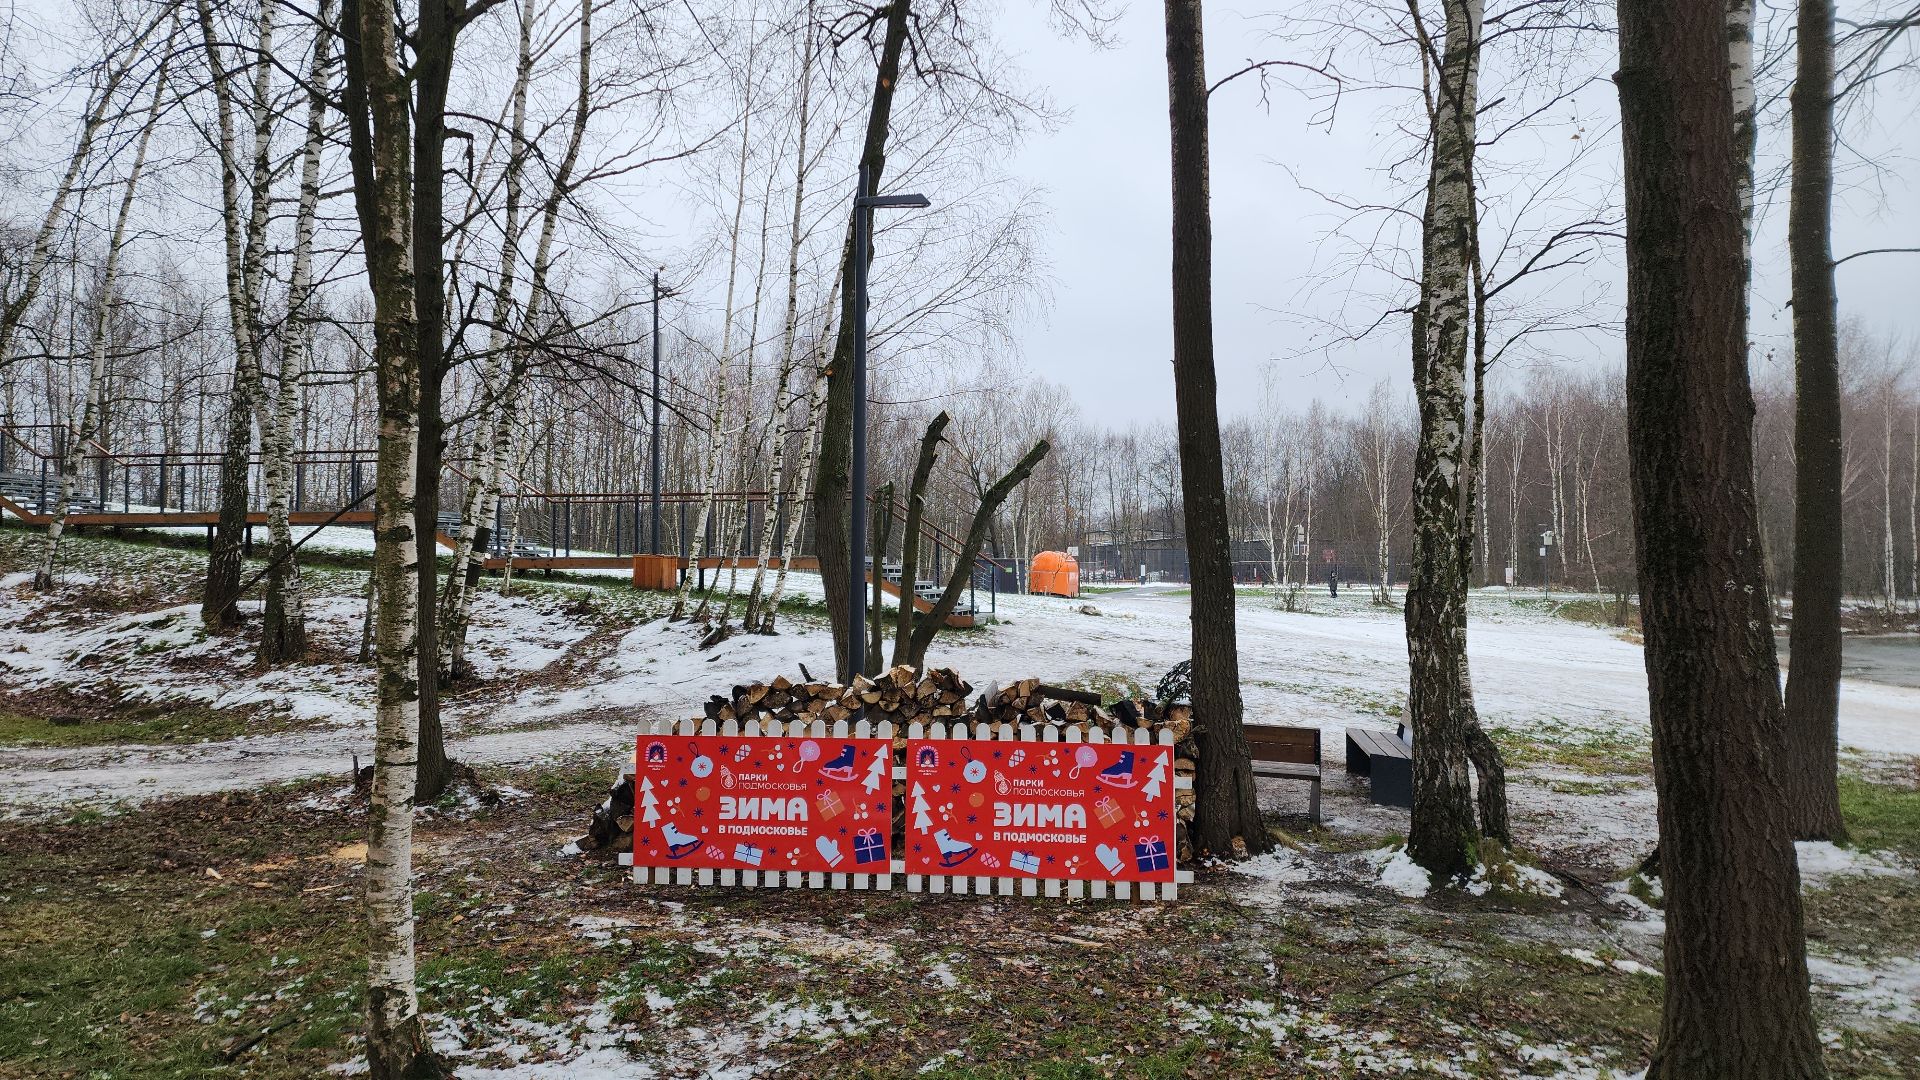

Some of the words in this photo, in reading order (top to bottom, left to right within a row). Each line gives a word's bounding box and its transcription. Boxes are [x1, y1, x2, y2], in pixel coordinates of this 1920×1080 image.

[739, 773, 768, 781] ПАРКИ
[738, 782, 807, 791] ПОДМОСКОВЬЯ
[1013, 779, 1044, 787] ПАРКИ
[1013, 788, 1085, 797] ПОДМОСКОВЬЯ
[719, 796, 808, 821] ЗИМА
[993, 802, 1087, 828] ЗИМА
[718, 825, 726, 834] В
[727, 825, 808, 836] ПОДМОСКОВЬЕ
[993, 832, 1001, 841] В
[1003, 832, 1087, 844] ПОДМОСКОВЬЕ
